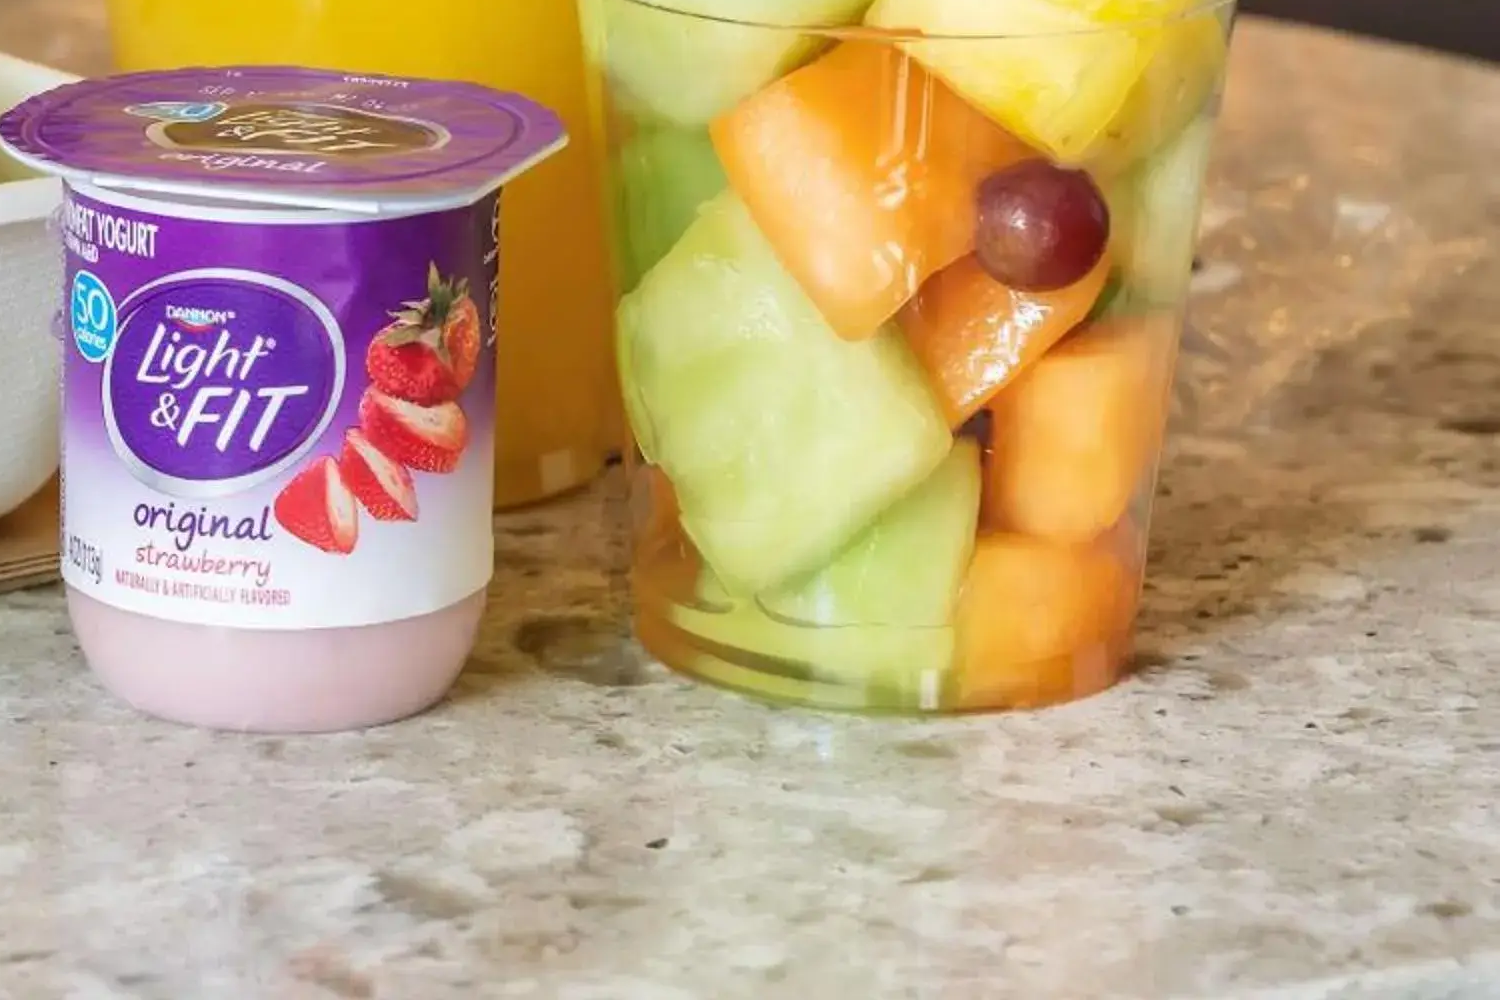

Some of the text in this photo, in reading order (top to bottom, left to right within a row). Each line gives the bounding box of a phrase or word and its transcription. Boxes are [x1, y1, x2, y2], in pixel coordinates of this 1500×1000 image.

[158, 152, 327, 174] original
[97, 213, 159, 259] YOGURT
[75, 283, 108, 331] 50
[166, 305, 227, 324] DANNON
[136, 322, 269, 389] Light
[134, 502, 273, 551] original
[115, 569, 160, 594] NATURALLY
[172, 581, 235, 603] ARTIFICIALLY
[240, 588, 291, 606] FLAVORED
[135, 543, 271, 587] strawberry
